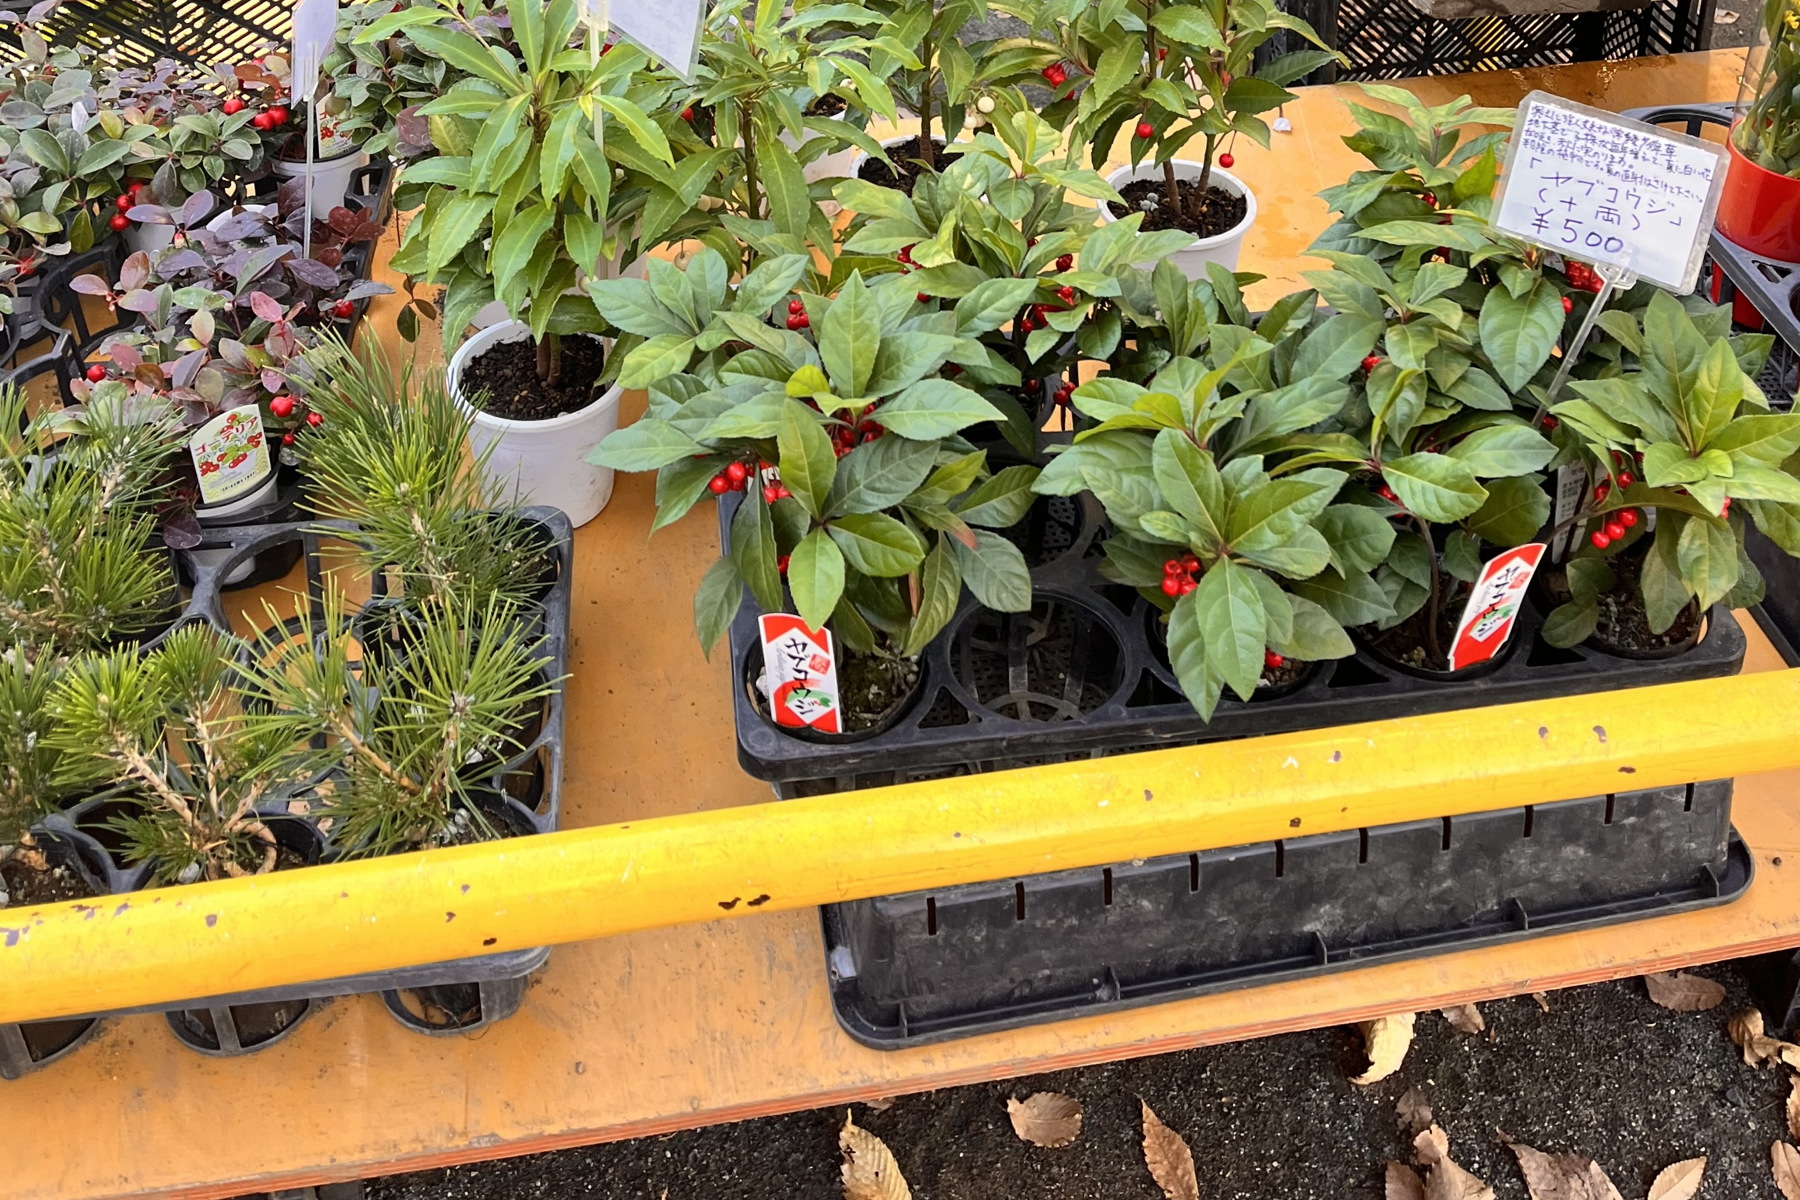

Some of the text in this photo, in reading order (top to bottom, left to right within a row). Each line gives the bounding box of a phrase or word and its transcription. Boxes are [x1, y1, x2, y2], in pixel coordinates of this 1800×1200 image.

[1531, 207, 1624, 253] ¥500
[194, 416, 258, 456] ゴーテリア
[1477, 566, 1521, 638] ヤブコウジ
[785, 637, 814, 716] ヤブコウジ
